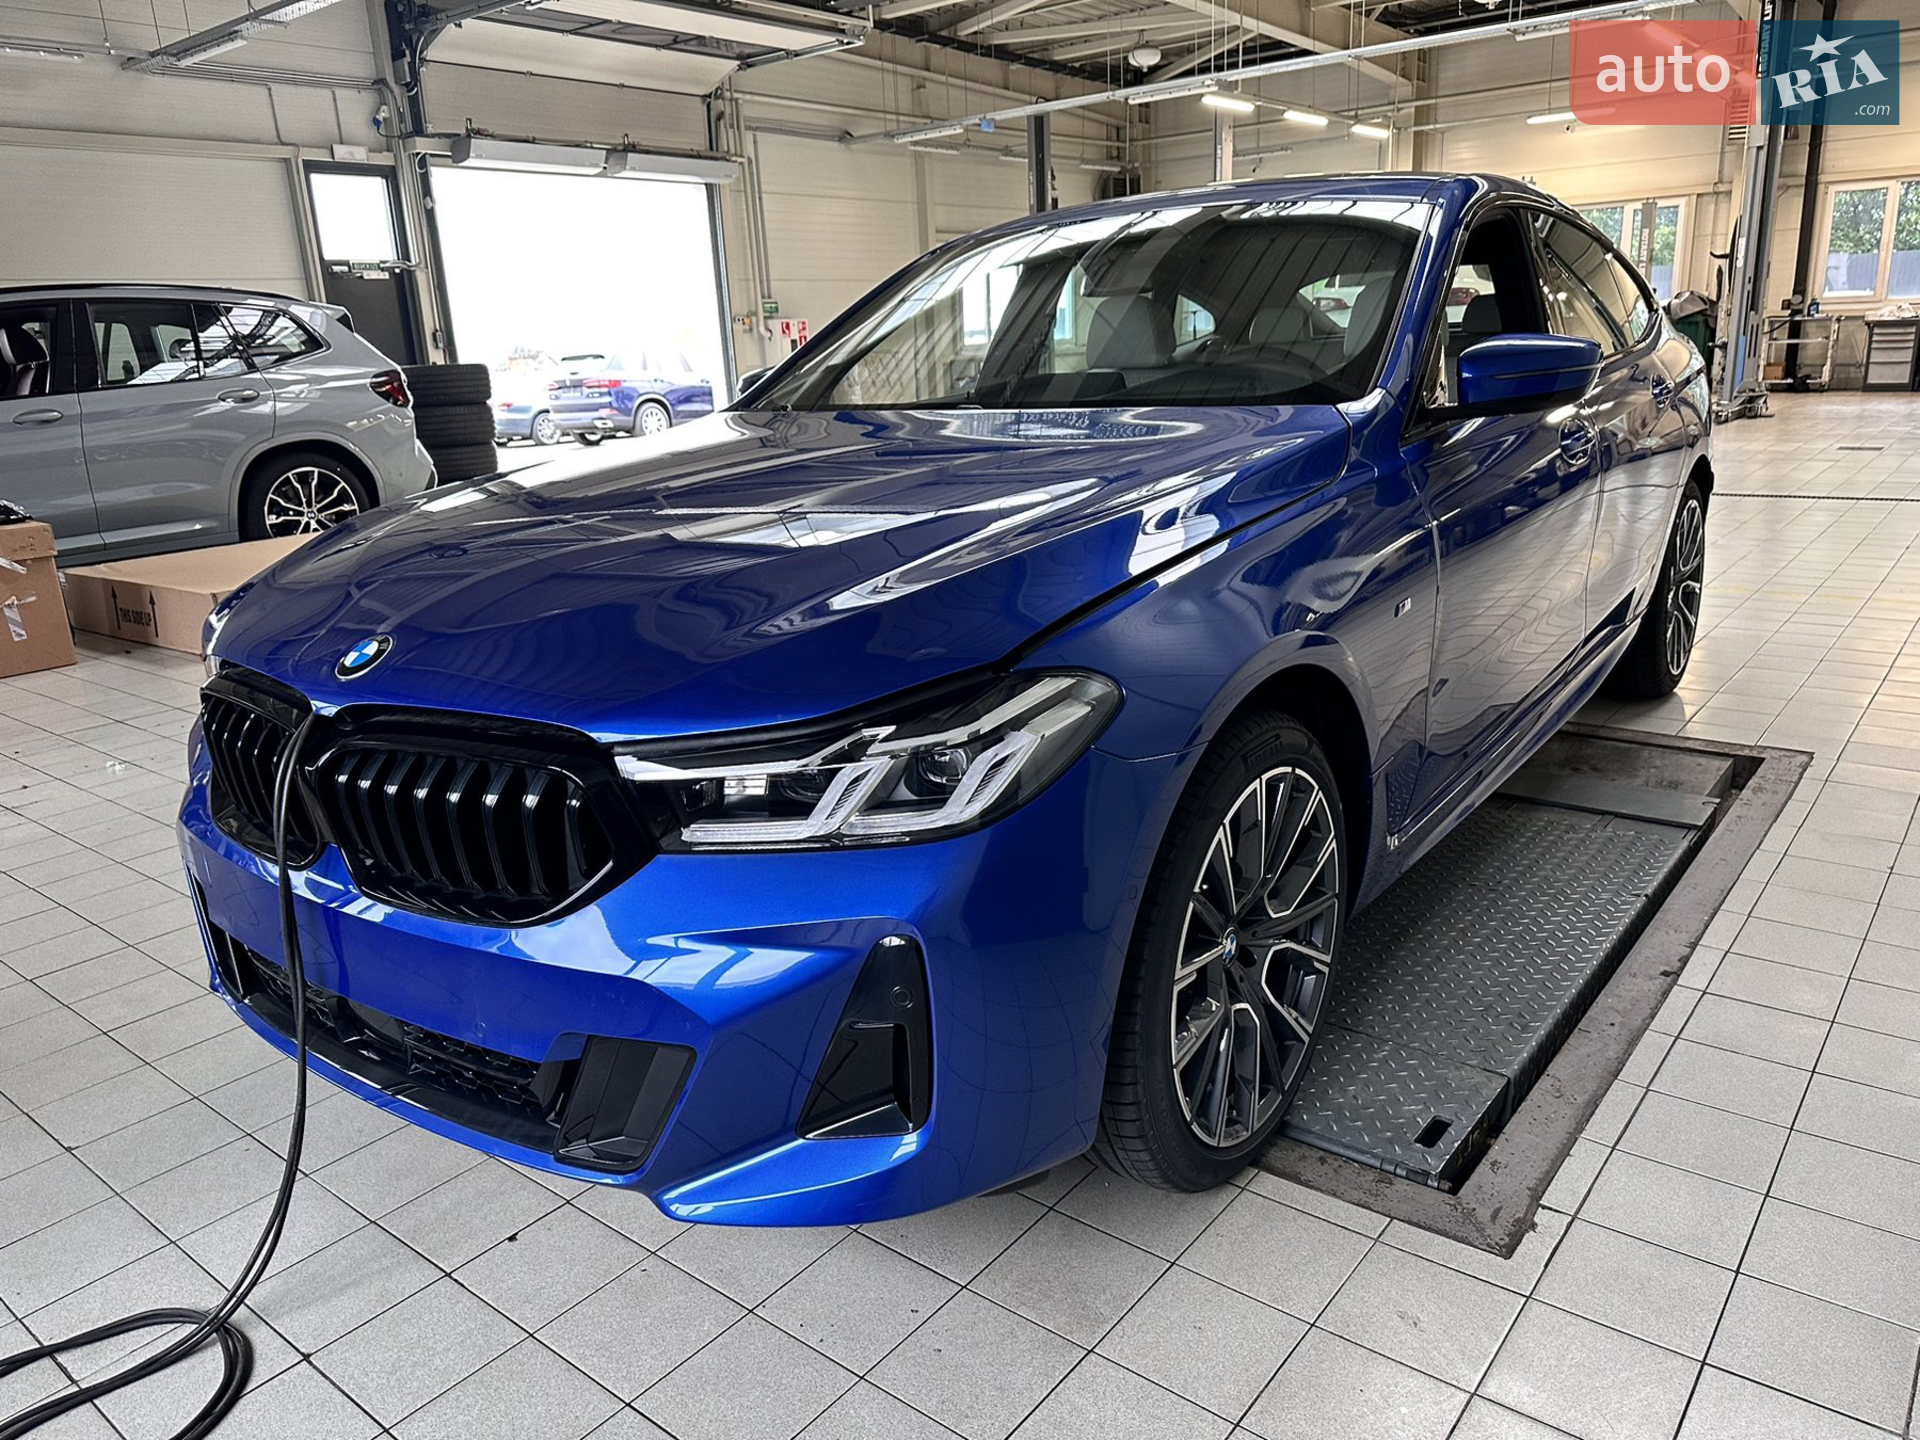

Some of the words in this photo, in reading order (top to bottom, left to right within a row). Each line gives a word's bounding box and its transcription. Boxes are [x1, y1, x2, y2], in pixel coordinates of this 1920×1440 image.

[1639, 228, 1649, 261] ROTARY
[119, 608, 131, 623] THIS
[131, 610, 144, 625] SIDE
